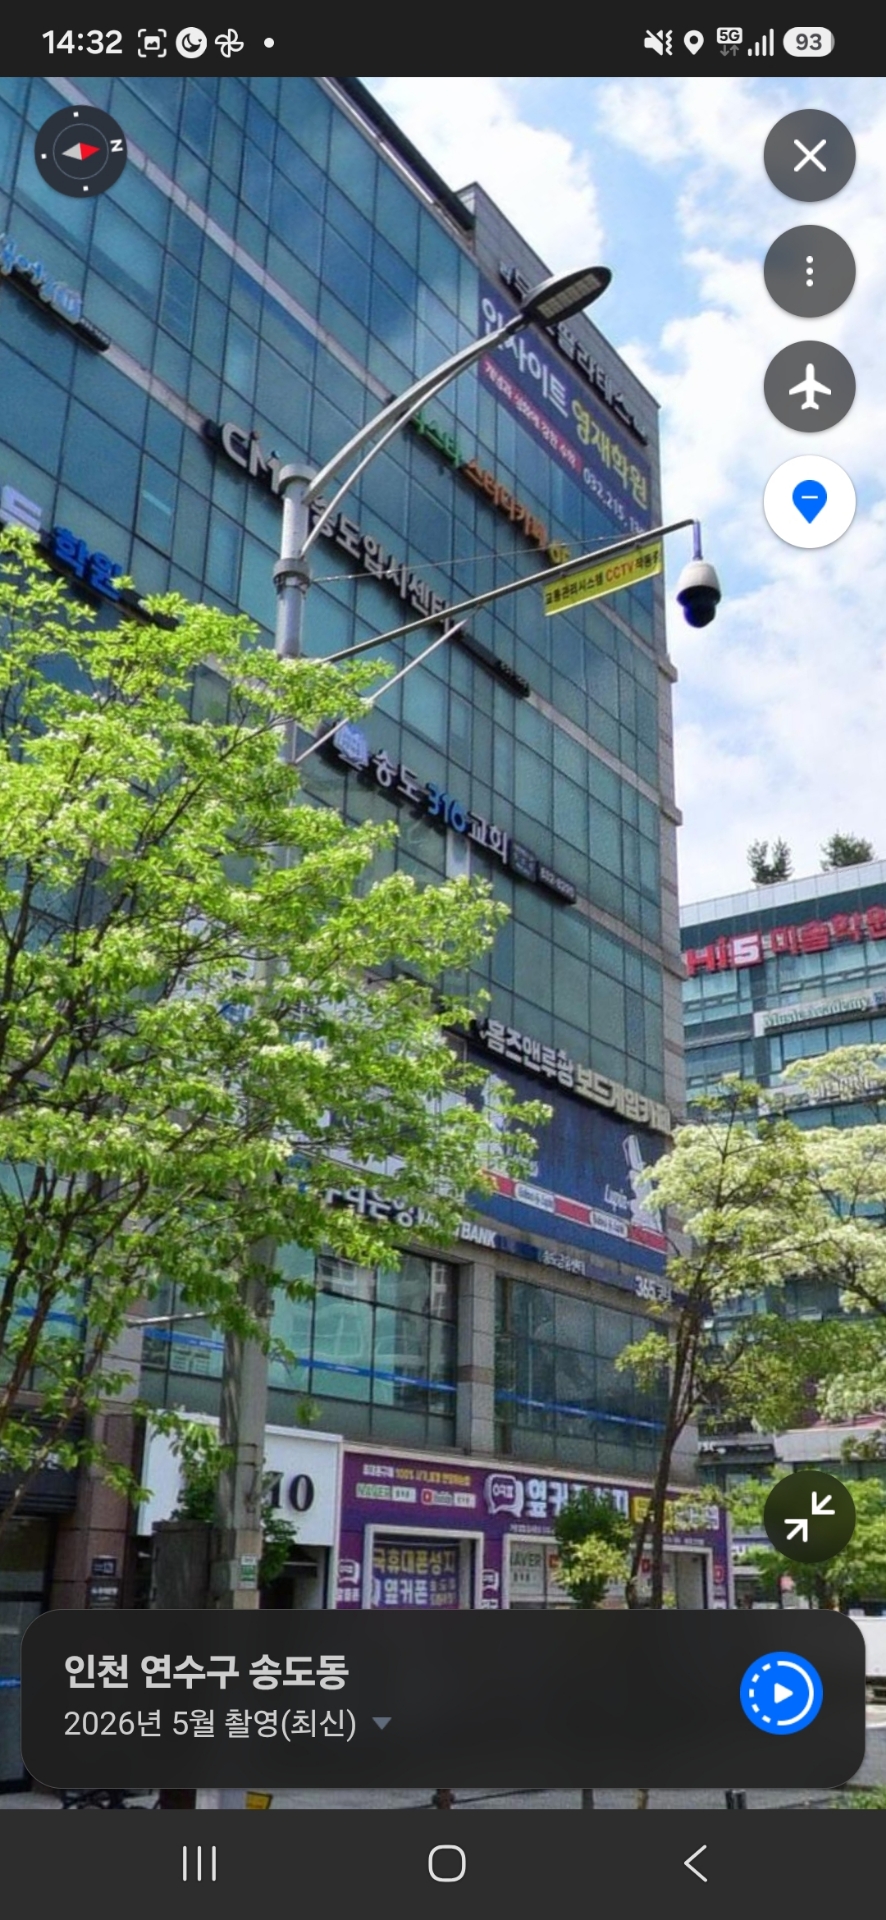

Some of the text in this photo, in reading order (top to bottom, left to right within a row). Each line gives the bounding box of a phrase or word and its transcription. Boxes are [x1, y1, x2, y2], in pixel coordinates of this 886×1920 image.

[220, 422, 284, 496] CM
[571, 398, 648, 512] 영재학원
[53, 526, 122, 603] 학원
[605, 562, 636, 583] CCTV
[769, 905, 886, 955] 미술학원
[573, 1062, 672, 1138] 보드게임카페
[460, 1221, 498, 1250] BANK
